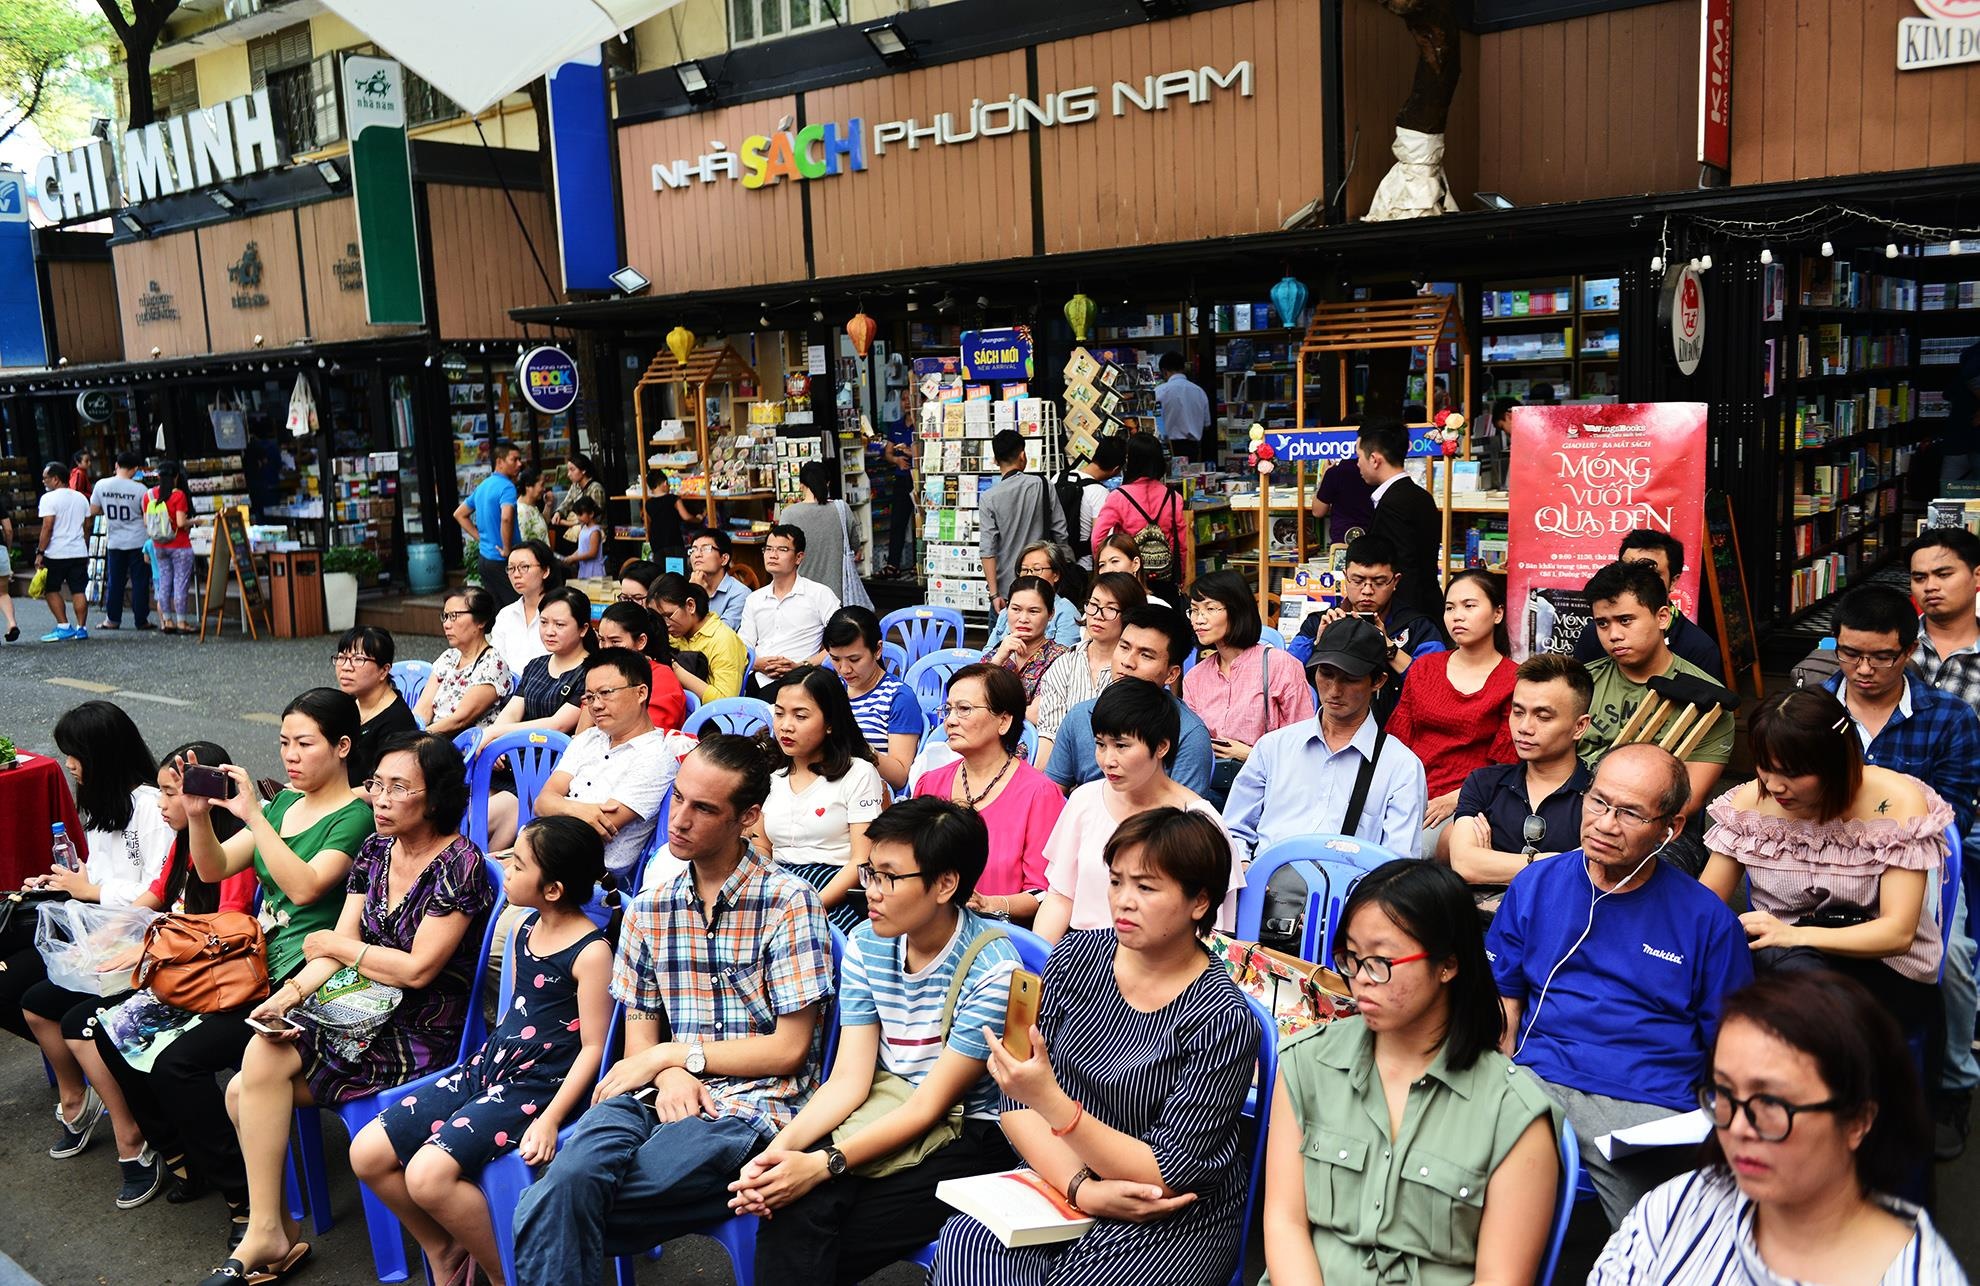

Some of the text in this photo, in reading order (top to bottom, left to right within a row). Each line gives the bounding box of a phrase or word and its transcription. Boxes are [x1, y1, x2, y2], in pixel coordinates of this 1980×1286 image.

[1904, 24, 1950, 63] KIM
[1711, 19, 1723, 123] KIM
[651, 60, 1254, 191] NHÀ SÁCH PHƯƠNG NAM
[35, 88, 279, 222] CHI MINH
[974, 346, 1019, 365] SÁCH MỚI
[531, 370, 572, 387] BOOK
[531, 385, 573, 395] STORE
[1288, 438, 1357, 461] phuong
[1631, 439, 1651, 448] SÁCH
[1552, 451, 1651, 488] MÓNG
[1563, 479, 1638, 507] VUỐT
[107, 504, 130, 520] 00
[1554, 626, 1583, 639] VUỐ
